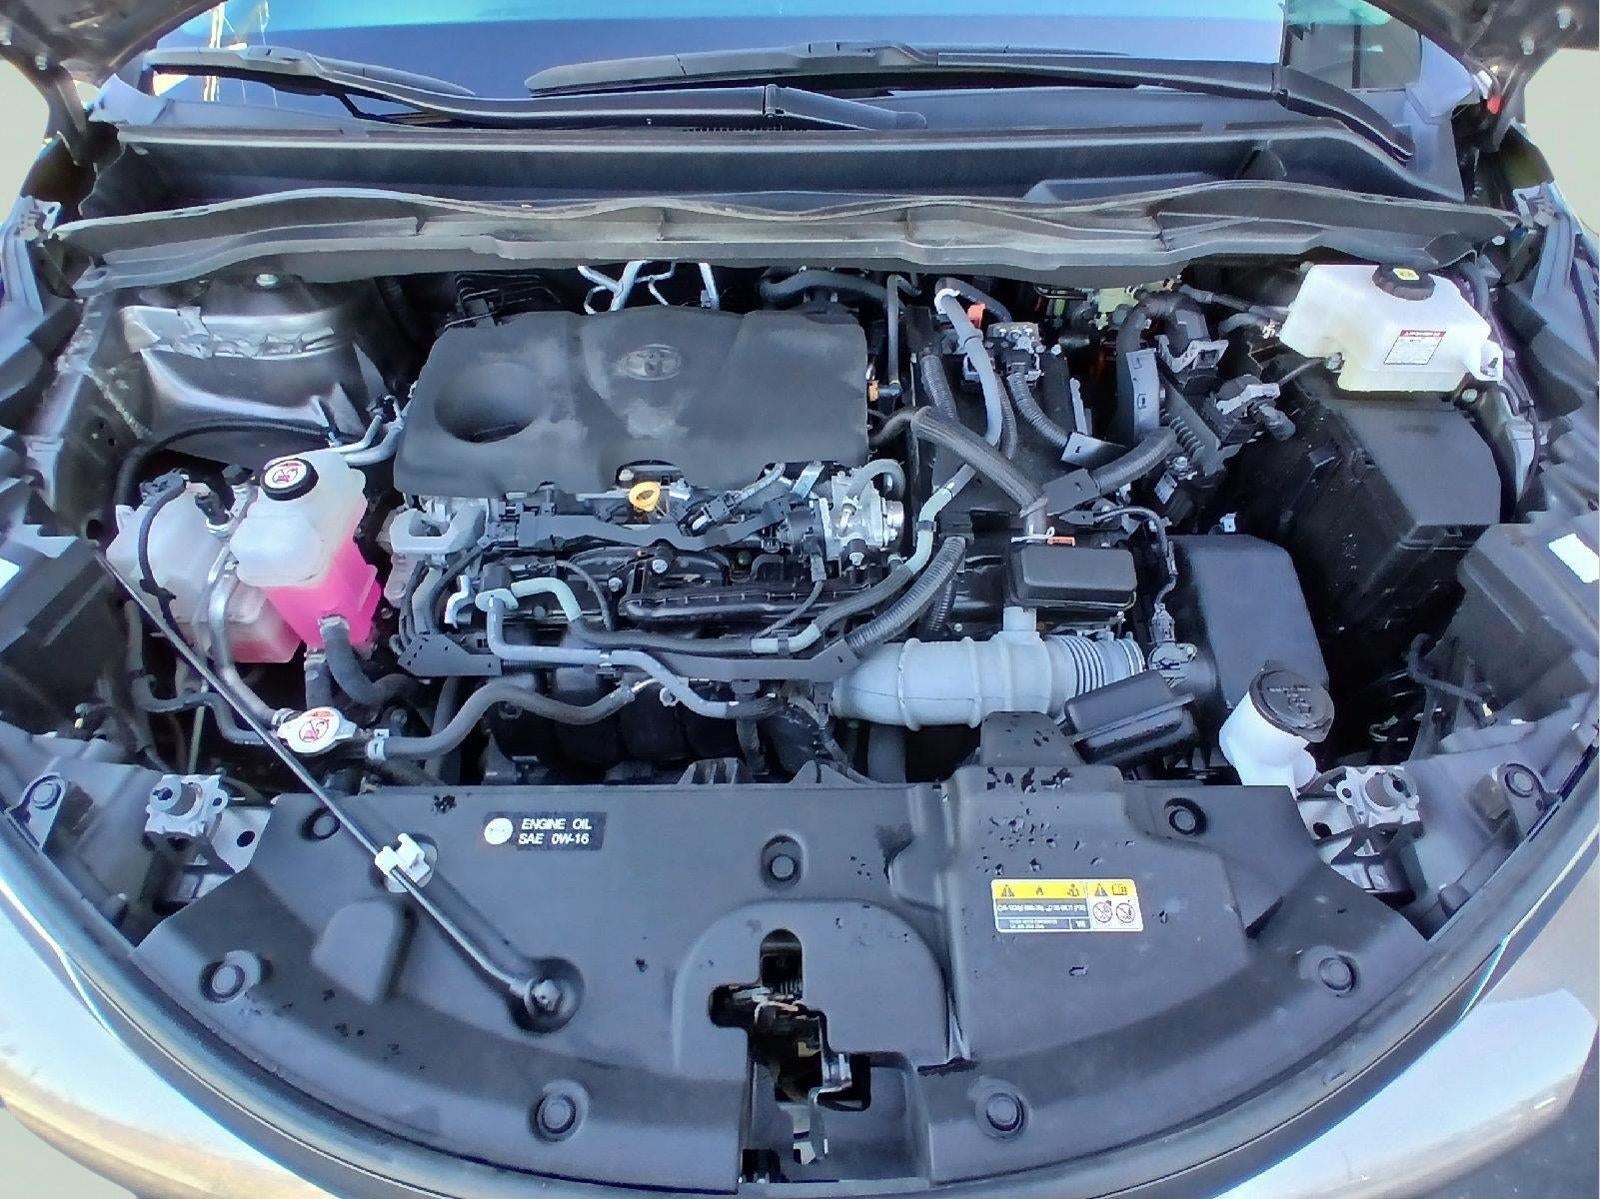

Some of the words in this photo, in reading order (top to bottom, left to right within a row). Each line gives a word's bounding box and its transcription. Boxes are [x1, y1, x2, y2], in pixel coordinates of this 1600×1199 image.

[521, 818, 566, 830] ENGINE
[572, 818, 593, 830] OIL
[518, 832, 544, 845] SAE
[551, 832, 590, 845] 0W-16
